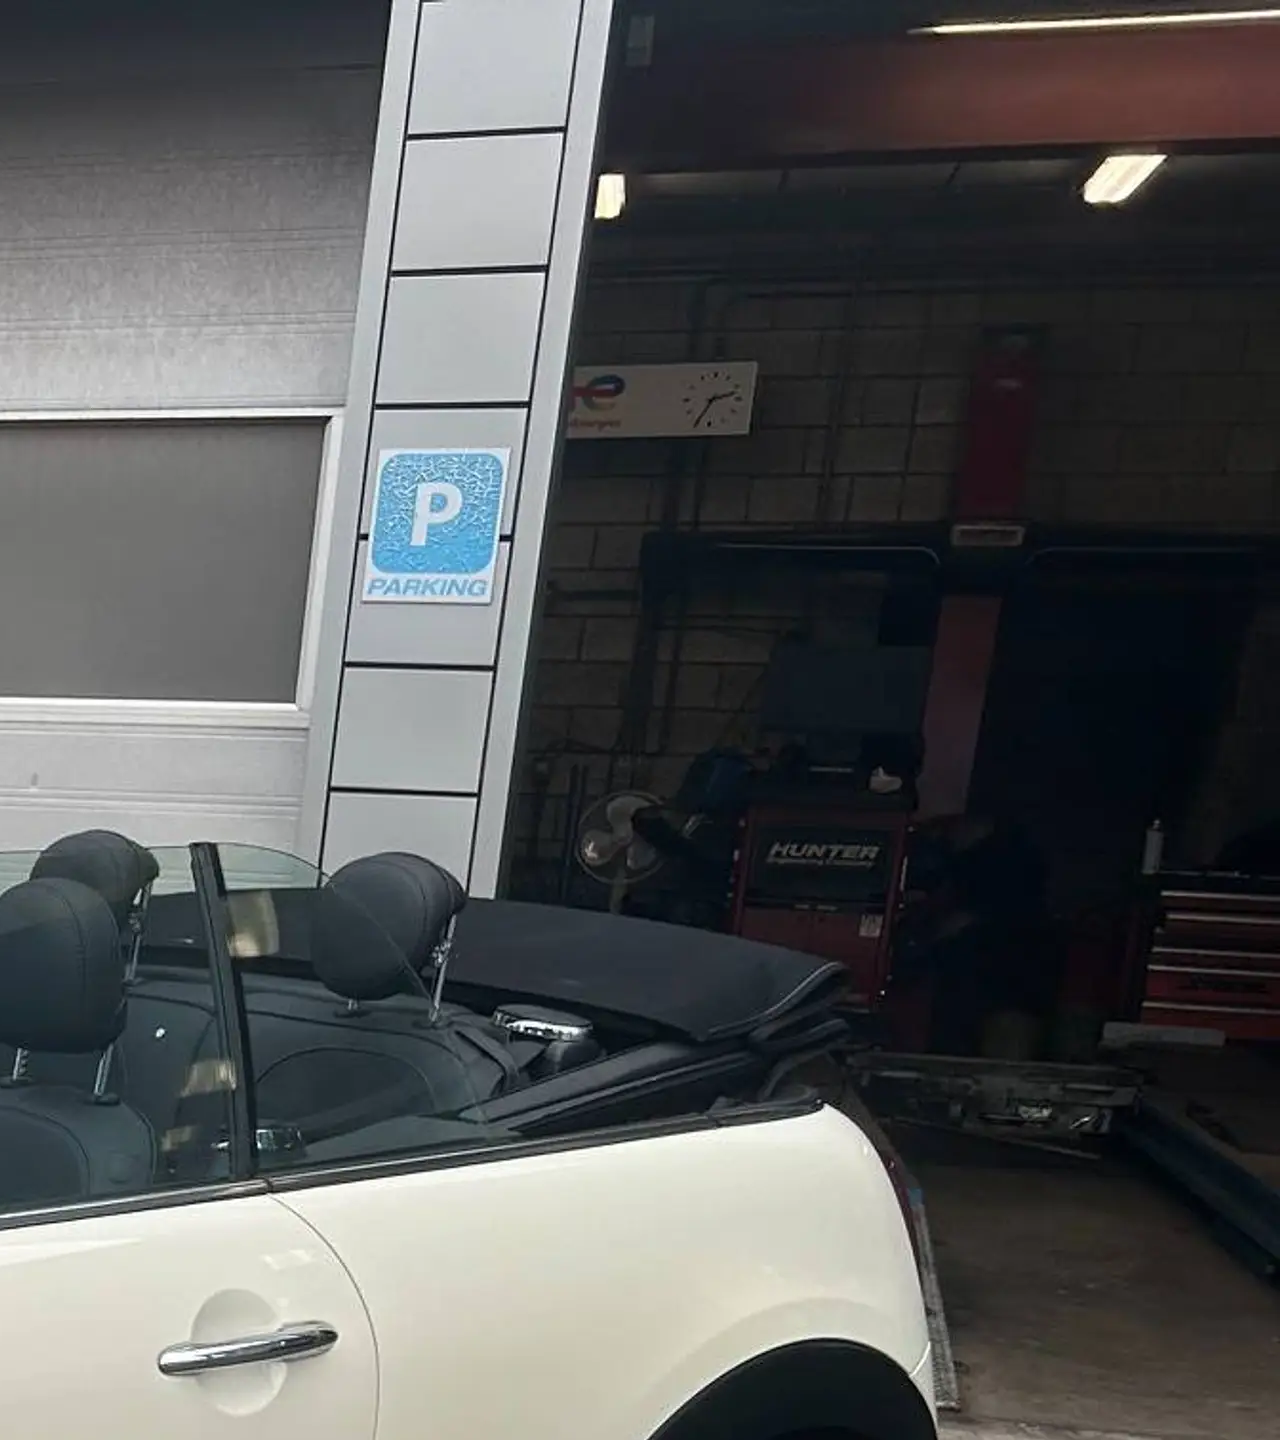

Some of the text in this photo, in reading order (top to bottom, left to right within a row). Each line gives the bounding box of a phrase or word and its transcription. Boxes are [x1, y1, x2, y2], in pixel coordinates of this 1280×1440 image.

[410, 482, 462, 546] P
[367, 578, 487, 596] PARKING
[767, 841, 882, 861] HUNTER
